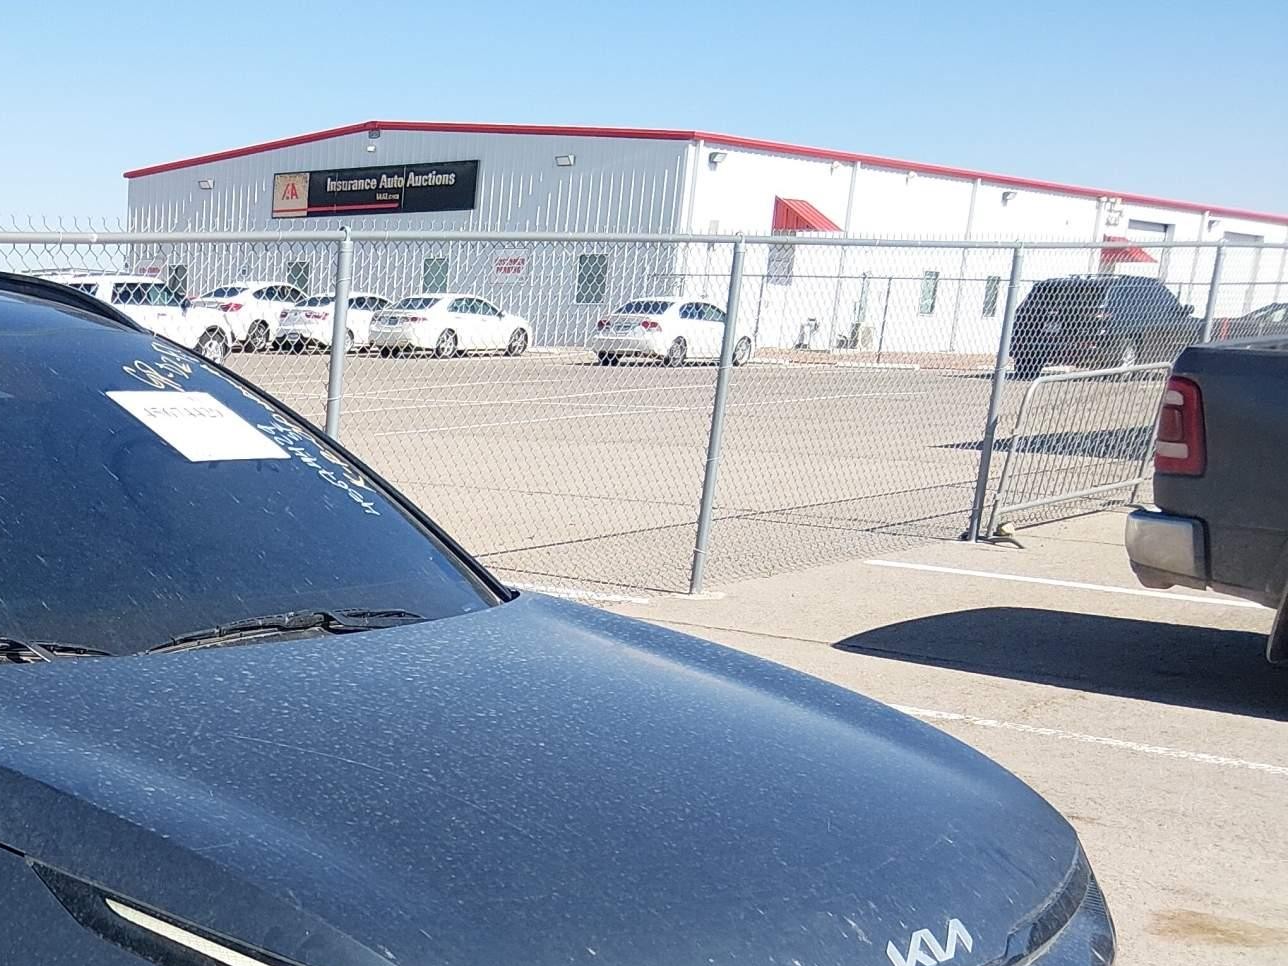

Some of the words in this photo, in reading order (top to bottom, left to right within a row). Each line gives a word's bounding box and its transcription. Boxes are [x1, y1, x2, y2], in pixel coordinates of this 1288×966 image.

[326, 177, 377, 192] Insurance
[379, 174, 404, 189] Auto
[407, 170, 455, 187] Auctions
